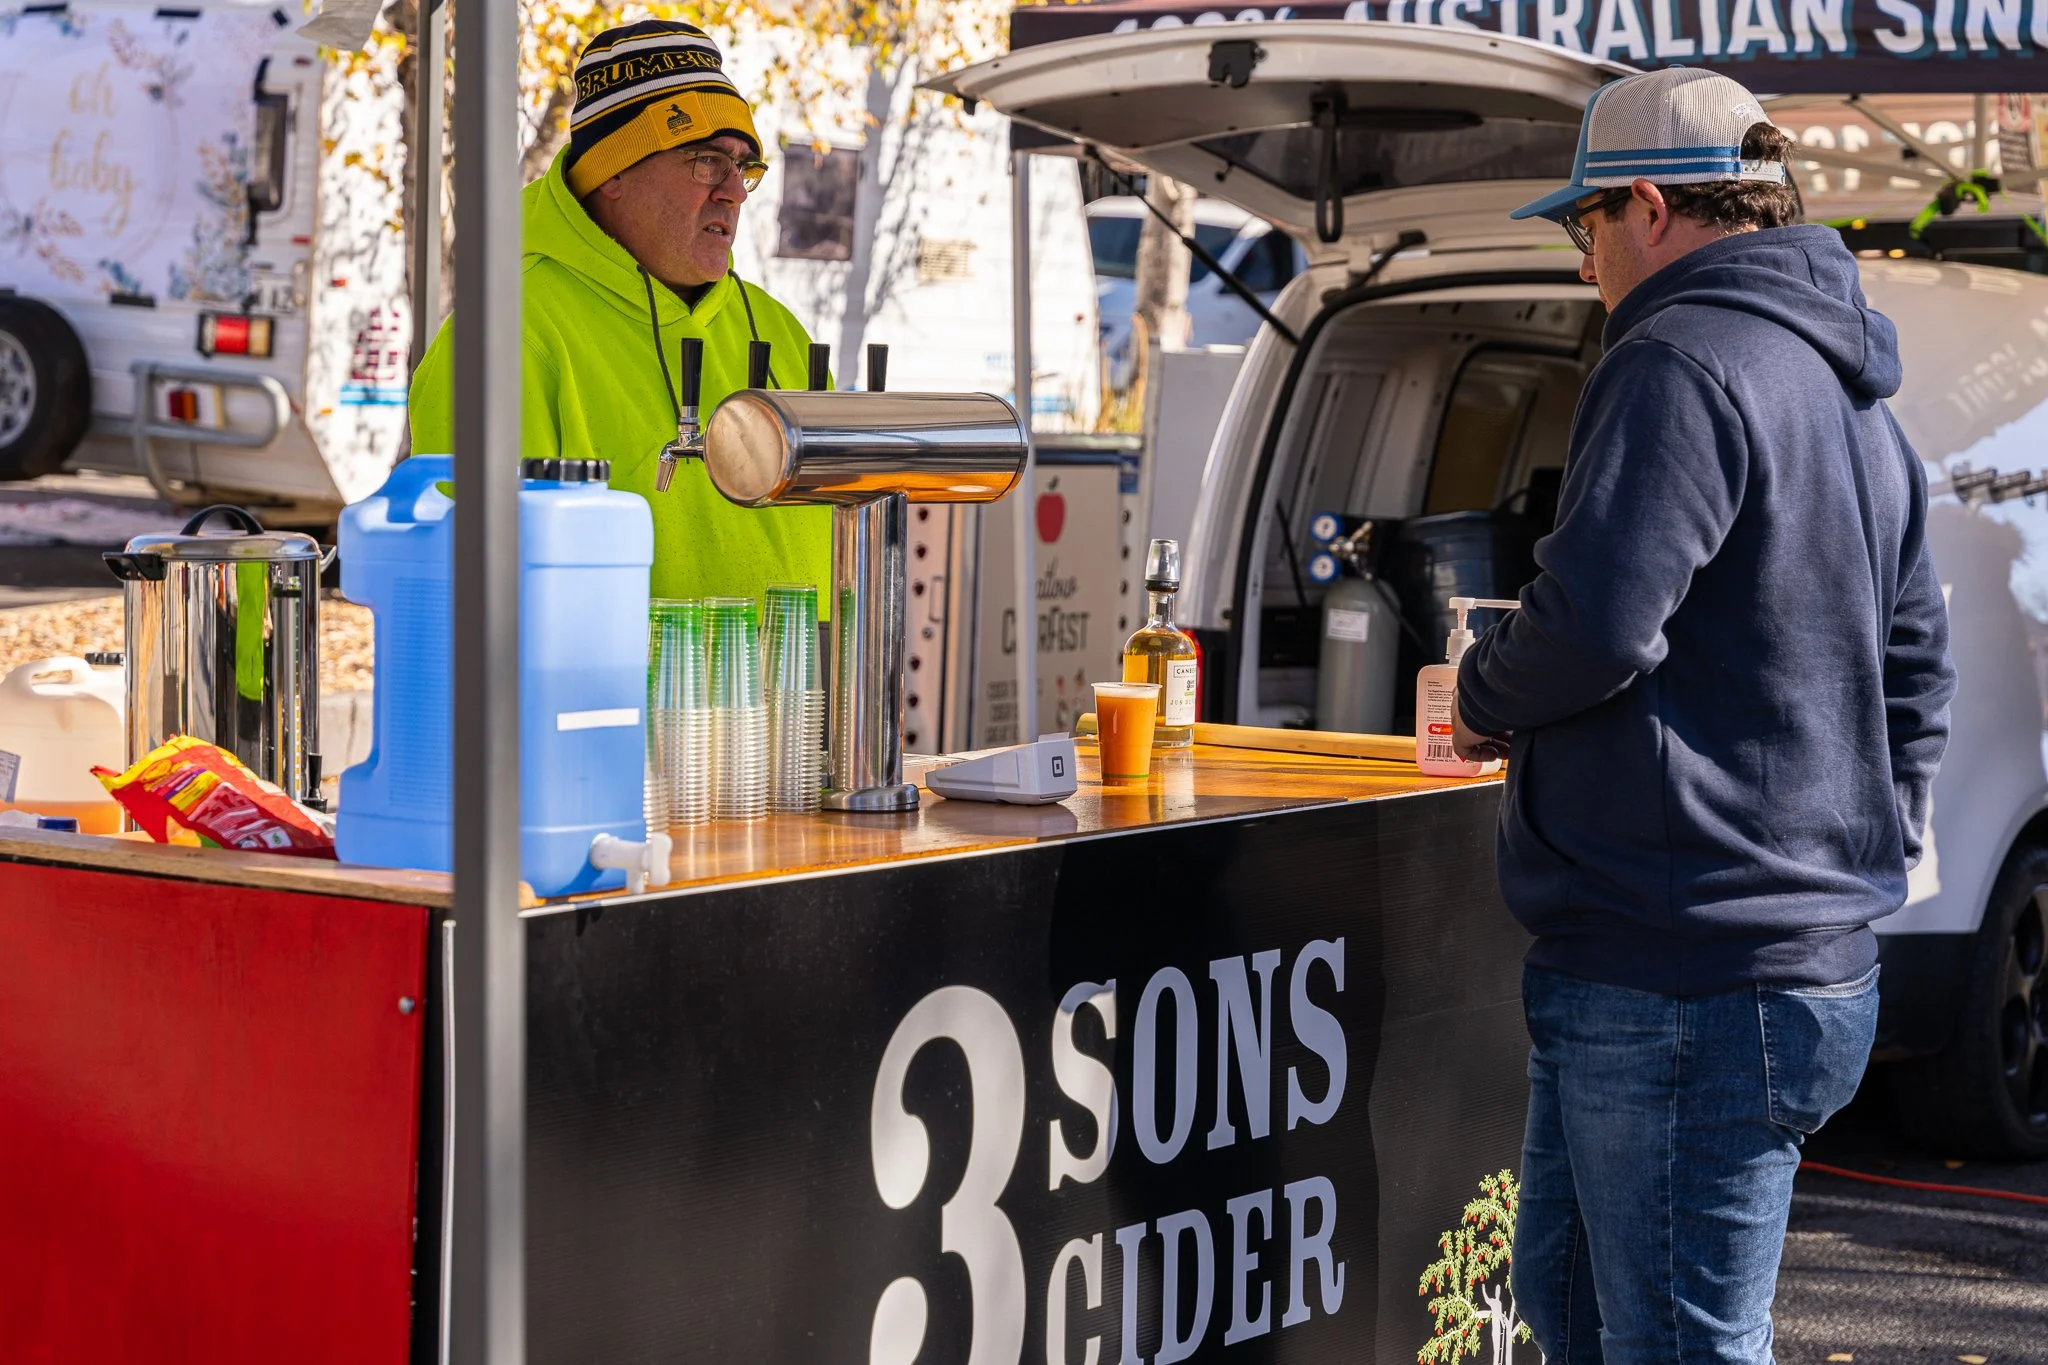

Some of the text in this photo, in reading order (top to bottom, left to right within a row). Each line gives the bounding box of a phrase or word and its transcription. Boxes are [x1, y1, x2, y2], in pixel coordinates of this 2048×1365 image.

[49, 127, 140, 237] baby
[870, 936, 1348, 1365] 3 SONS
[1046, 1175, 1346, 1365] CIDER
